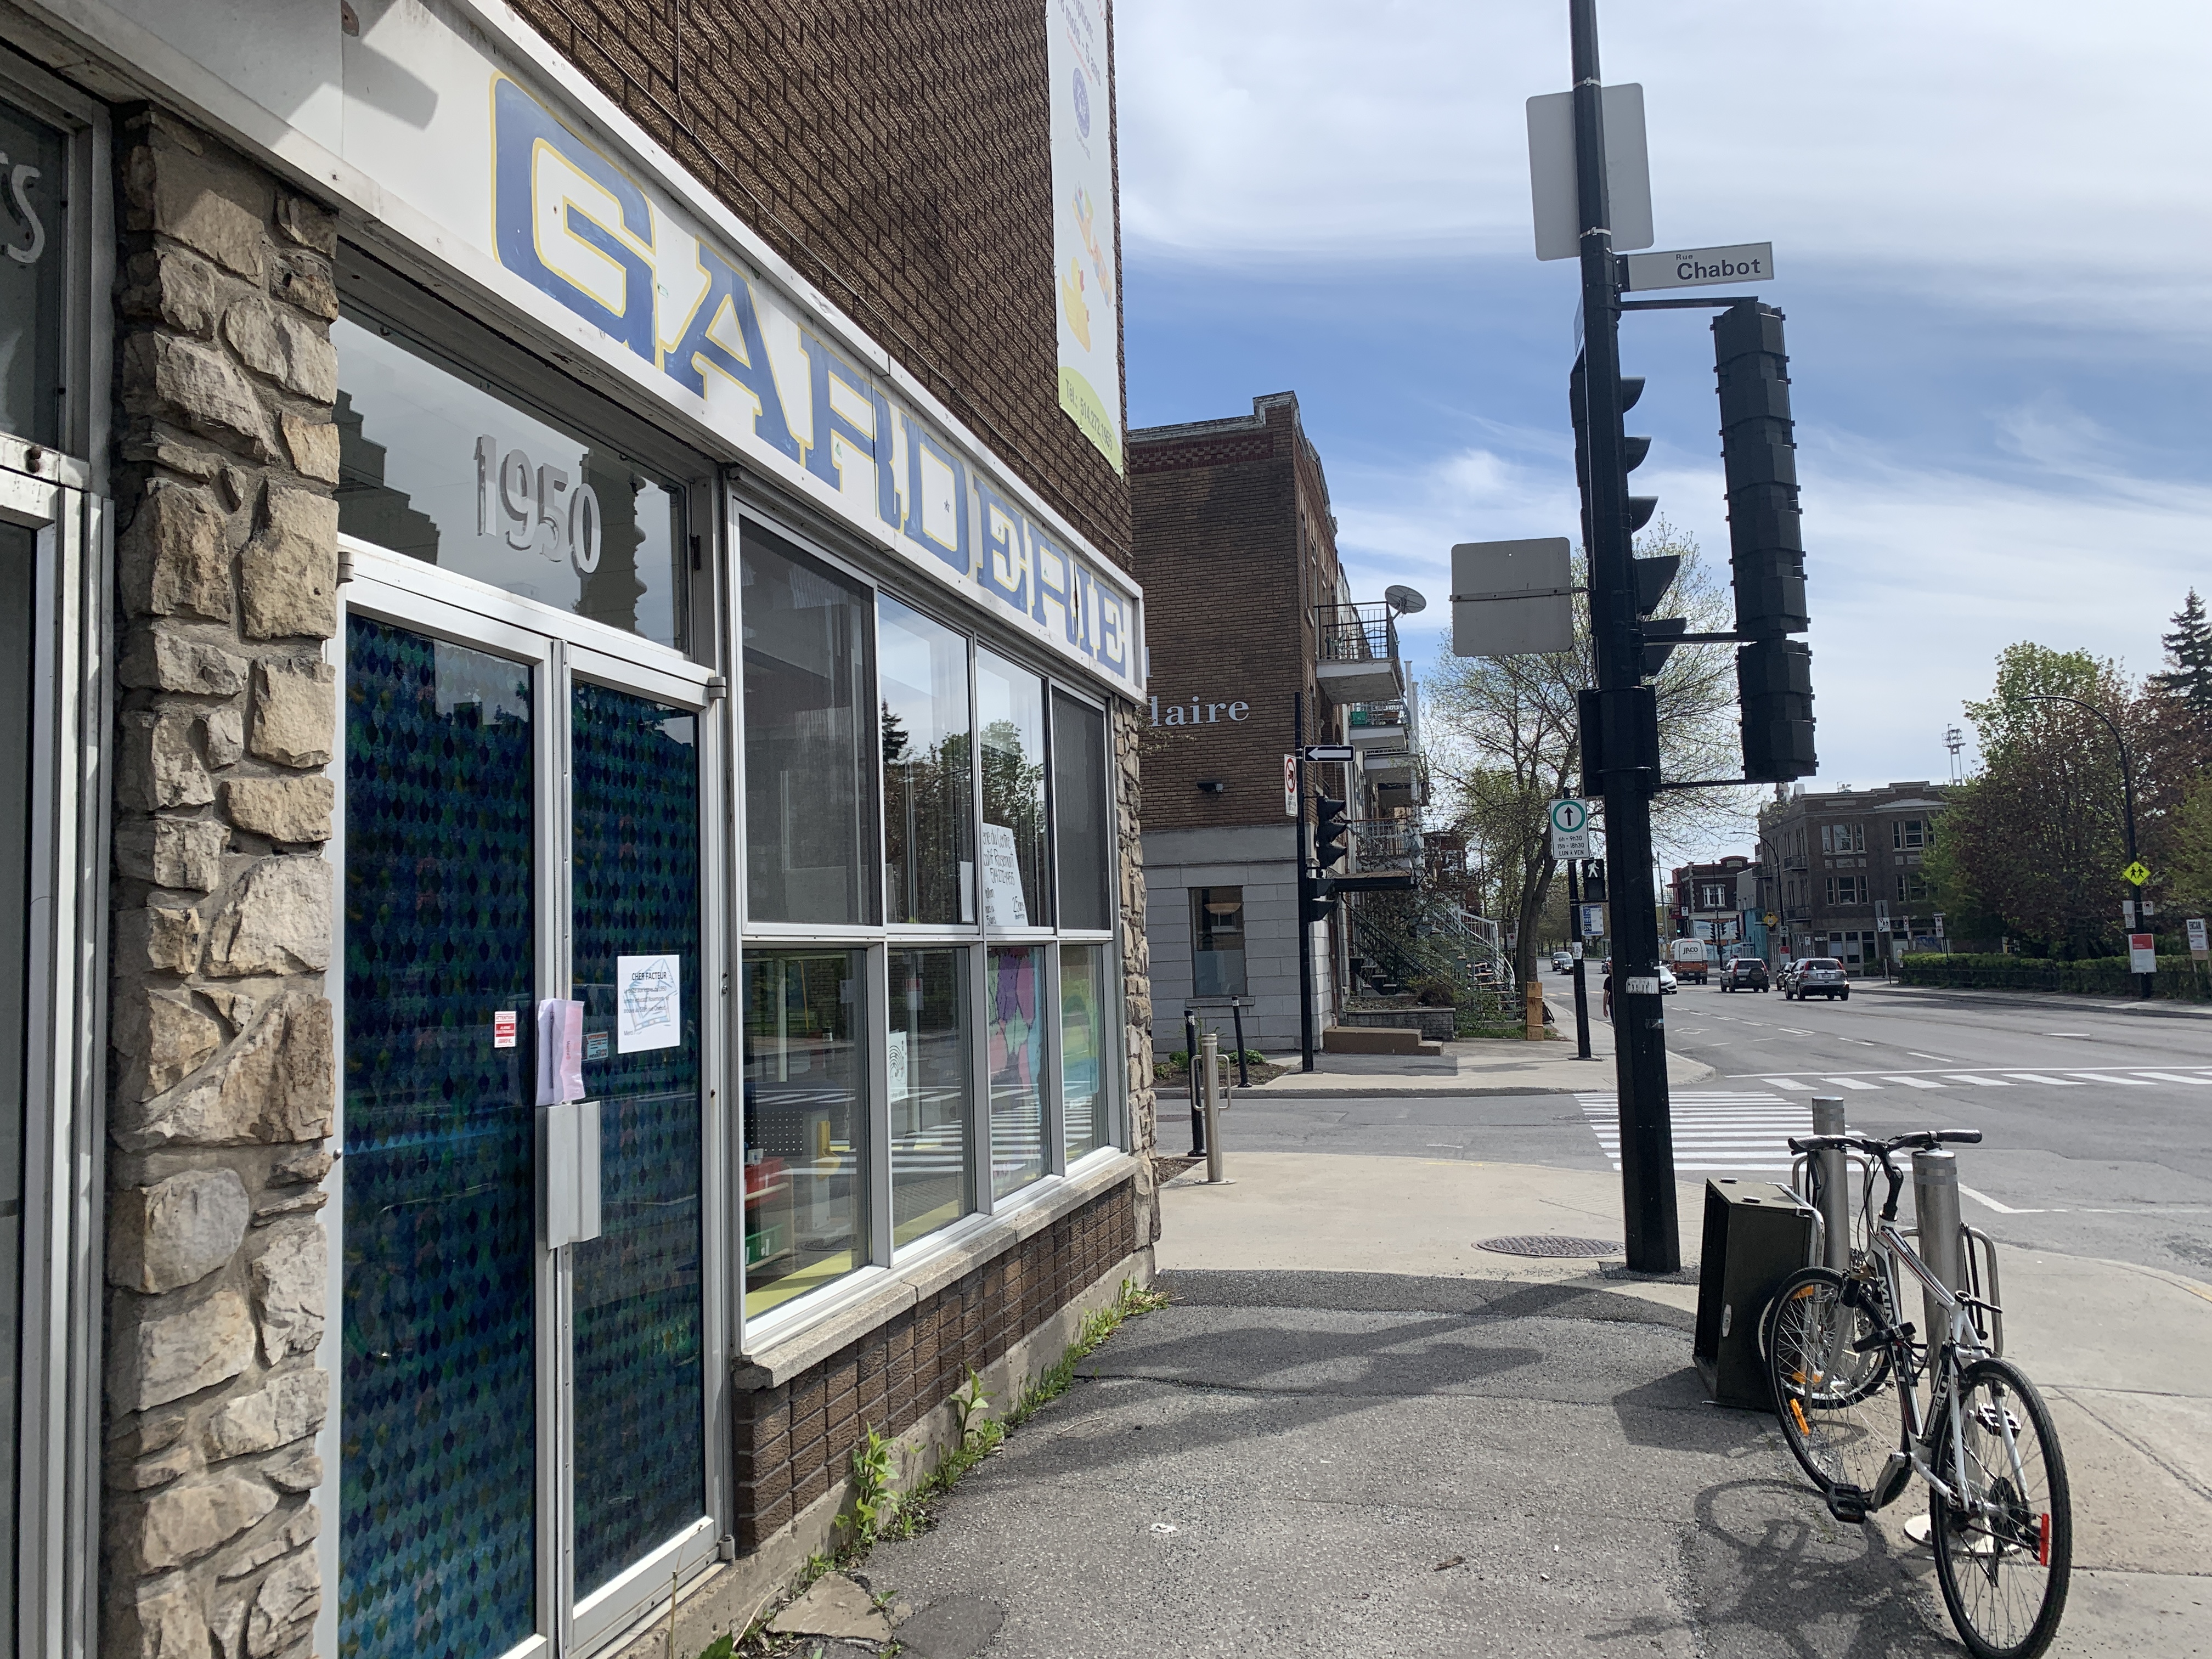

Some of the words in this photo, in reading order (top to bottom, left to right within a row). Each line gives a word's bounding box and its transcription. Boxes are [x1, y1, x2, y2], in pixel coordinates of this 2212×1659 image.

[1065, 5, 1080, 45] mois
[1086, 42, 1090, 64] 5
[1091, 57, 1101, 86] ans
[0, 151, 45, 263] S
[1677, 258, 1761, 280] Chabot
[489, 70, 1126, 679] GARDERIE
[1065, 378, 1078, 409] Tél.:
[474, 434, 601, 574] 1950
[631, 973, 645, 981] CHER
[646, 972, 667, 980] FACTEUR
[1877, 1276, 1906, 1383] MINLLI
